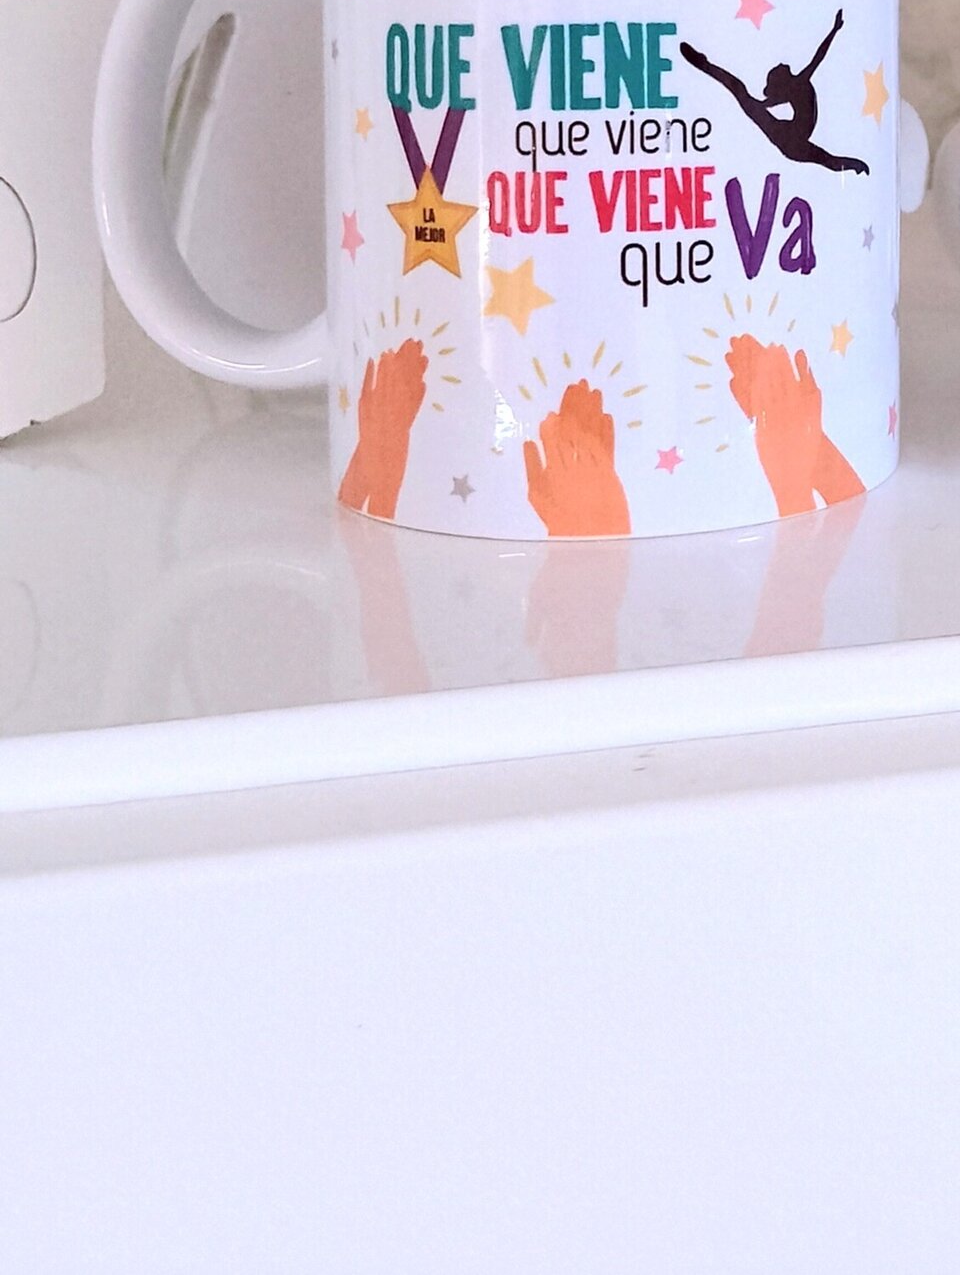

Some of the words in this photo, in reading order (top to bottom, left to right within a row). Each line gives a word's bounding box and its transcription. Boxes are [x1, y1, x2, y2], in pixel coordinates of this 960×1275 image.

[386, 23, 476, 112] QUE
[501, 21, 679, 111] VIENE
[515, 117, 590, 173] que
[605, 111, 712, 155] viene
[415, 226, 446, 243] MEJOR
[423, 208, 436, 223] LA
[486, 171, 569, 237] QUE
[588, 166, 717, 233] VIENE
[620, 239, 714, 307] que
[724, 173, 817, 280] Va
